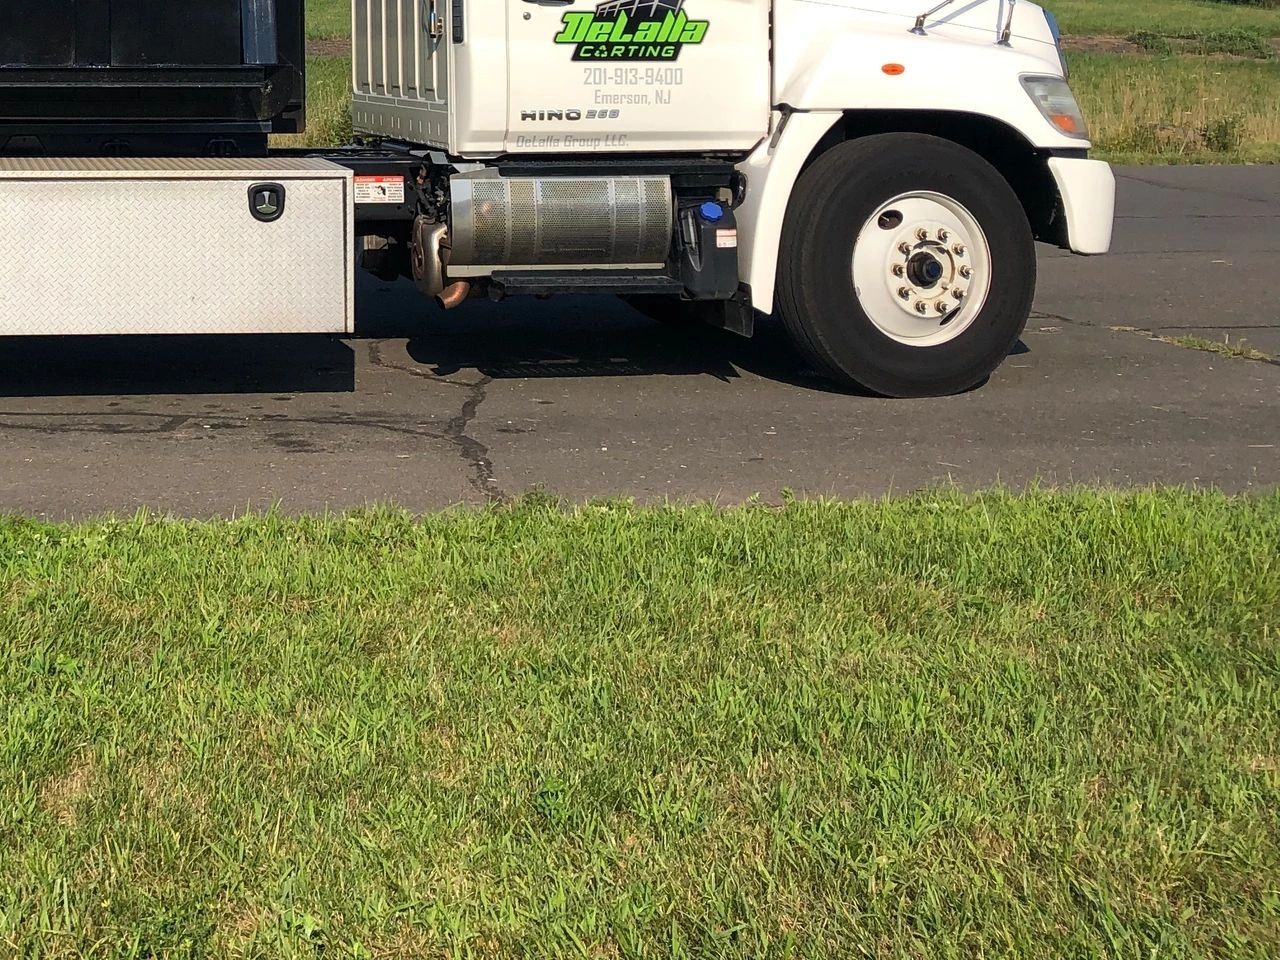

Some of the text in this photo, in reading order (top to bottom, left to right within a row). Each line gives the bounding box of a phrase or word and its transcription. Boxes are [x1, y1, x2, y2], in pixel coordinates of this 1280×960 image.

[554, 10, 708, 43] DeLalla
[583, 68, 683, 86] 201-913-9400
[594, 89, 671, 106] Emerson, NJ
[521, 109, 620, 121] HINO 268
[516, 134, 629, 150] DeLalla Group LLC.
